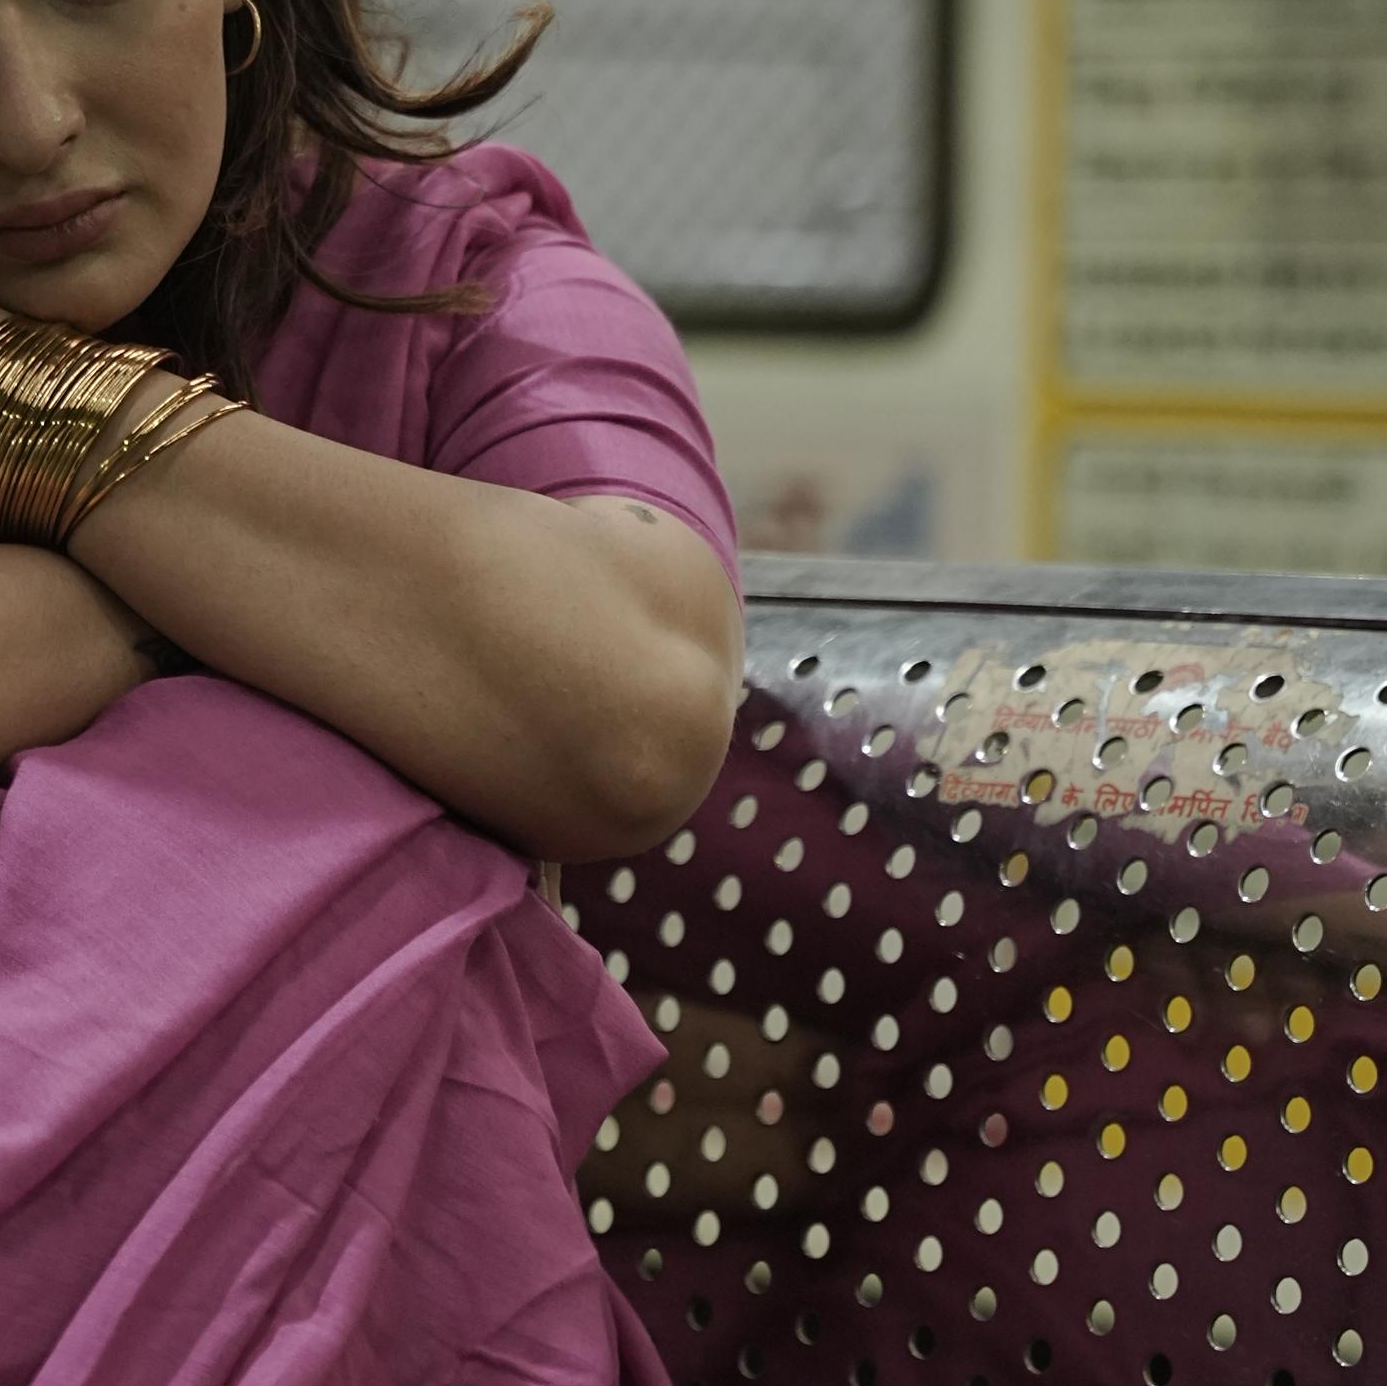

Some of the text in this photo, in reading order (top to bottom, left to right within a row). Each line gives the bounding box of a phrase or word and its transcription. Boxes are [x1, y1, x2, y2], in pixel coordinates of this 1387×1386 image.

[1061, 781, 1084, 808] के
[1093, 782, 1137, 812] लिए
[1155, 788, 1232, 821] मर्पित
